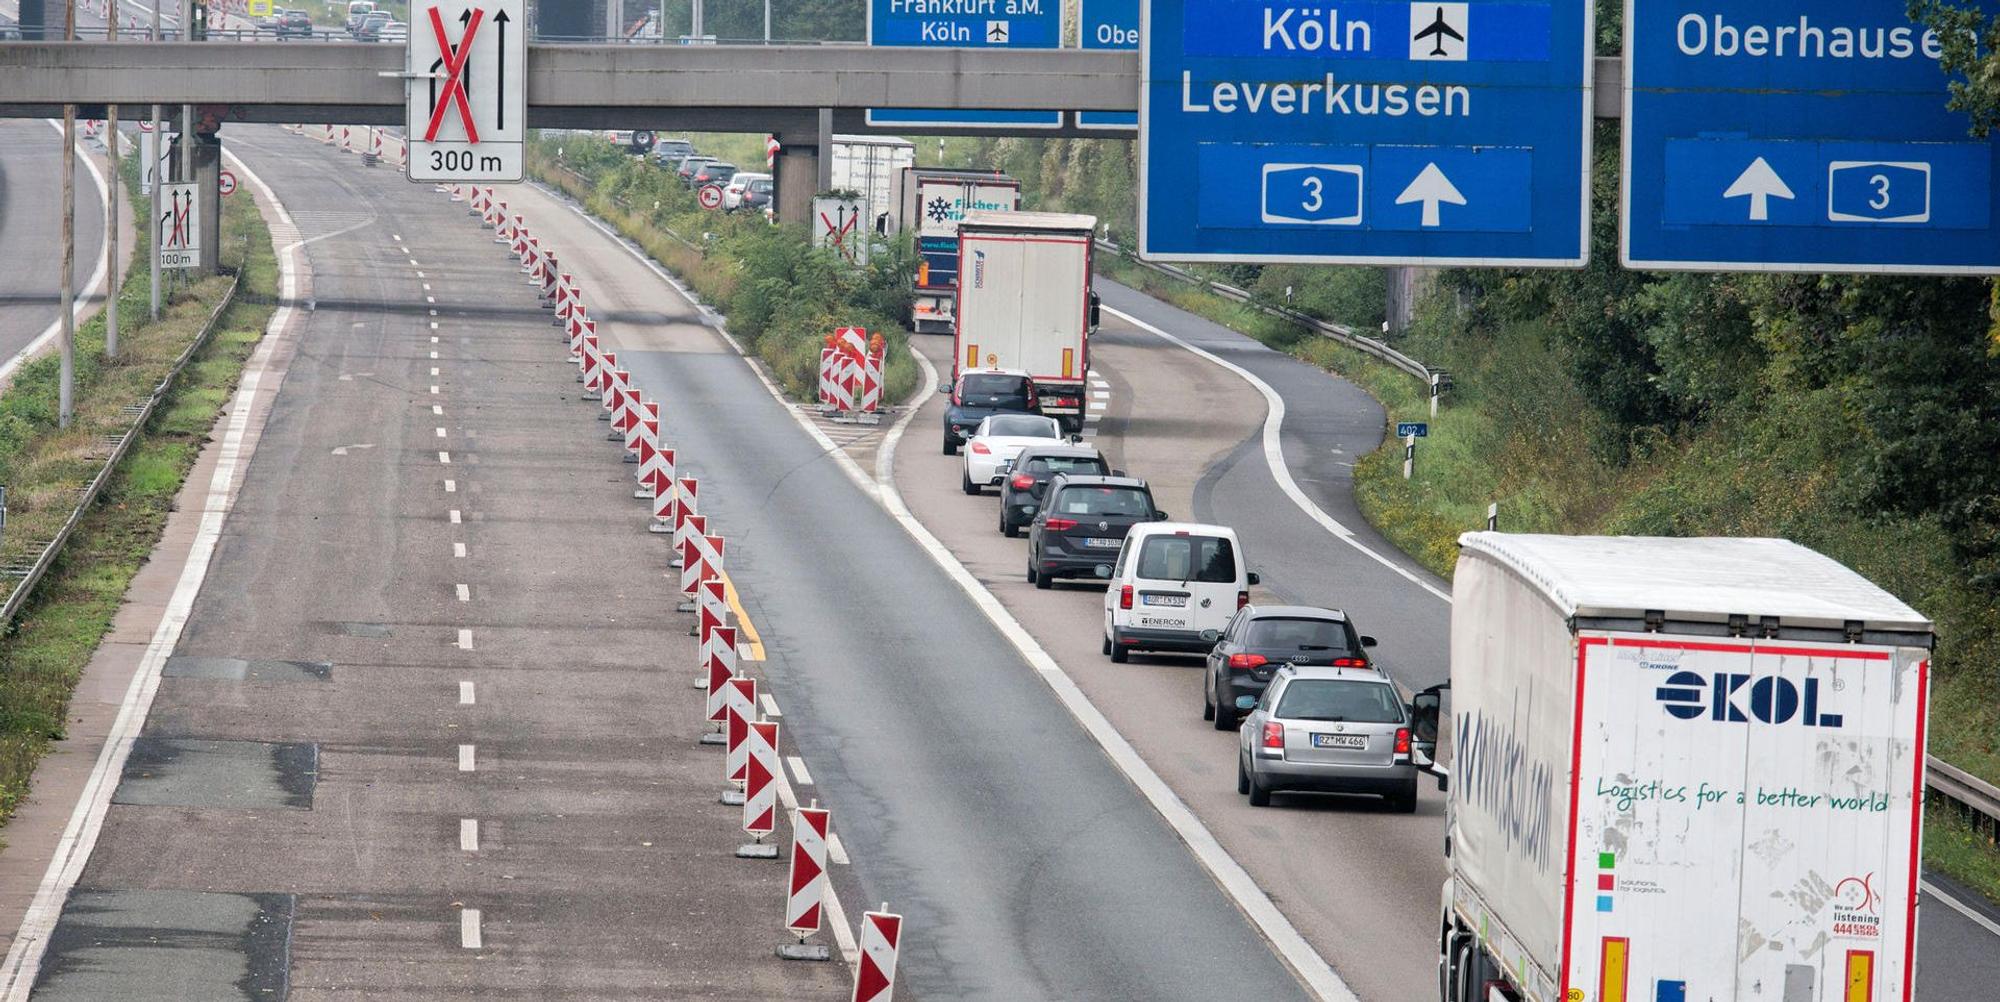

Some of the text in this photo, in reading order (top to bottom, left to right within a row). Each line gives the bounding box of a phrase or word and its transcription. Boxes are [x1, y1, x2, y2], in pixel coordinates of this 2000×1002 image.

[890, 0, 996, 14] Frankfurt
[921, 20, 971, 42] Köln
[1263, 7, 1372, 51] Köln
[1182, 70, 1471, 117] Leverkusen
[430, 150, 503, 172] 300 m
[1301, 176, 1324, 212] 3
[1868, 174, 1891, 210] 3
[955, 198, 1000, 211] Fischer
[161, 254, 191, 264] 100 m
[1148, 618, 1186, 626] ENERCON
[1649, 663, 1679, 671] KRONE
[1656, 671, 1844, 728] EKOL
[1319, 735, 1330, 745] RZ
[1349, 736, 1364, 747] 466
[1597, 777, 1890, 813] Logistics for a better world
[1834, 912, 1880, 926] listening
[1833, 923, 1853, 935] 444
